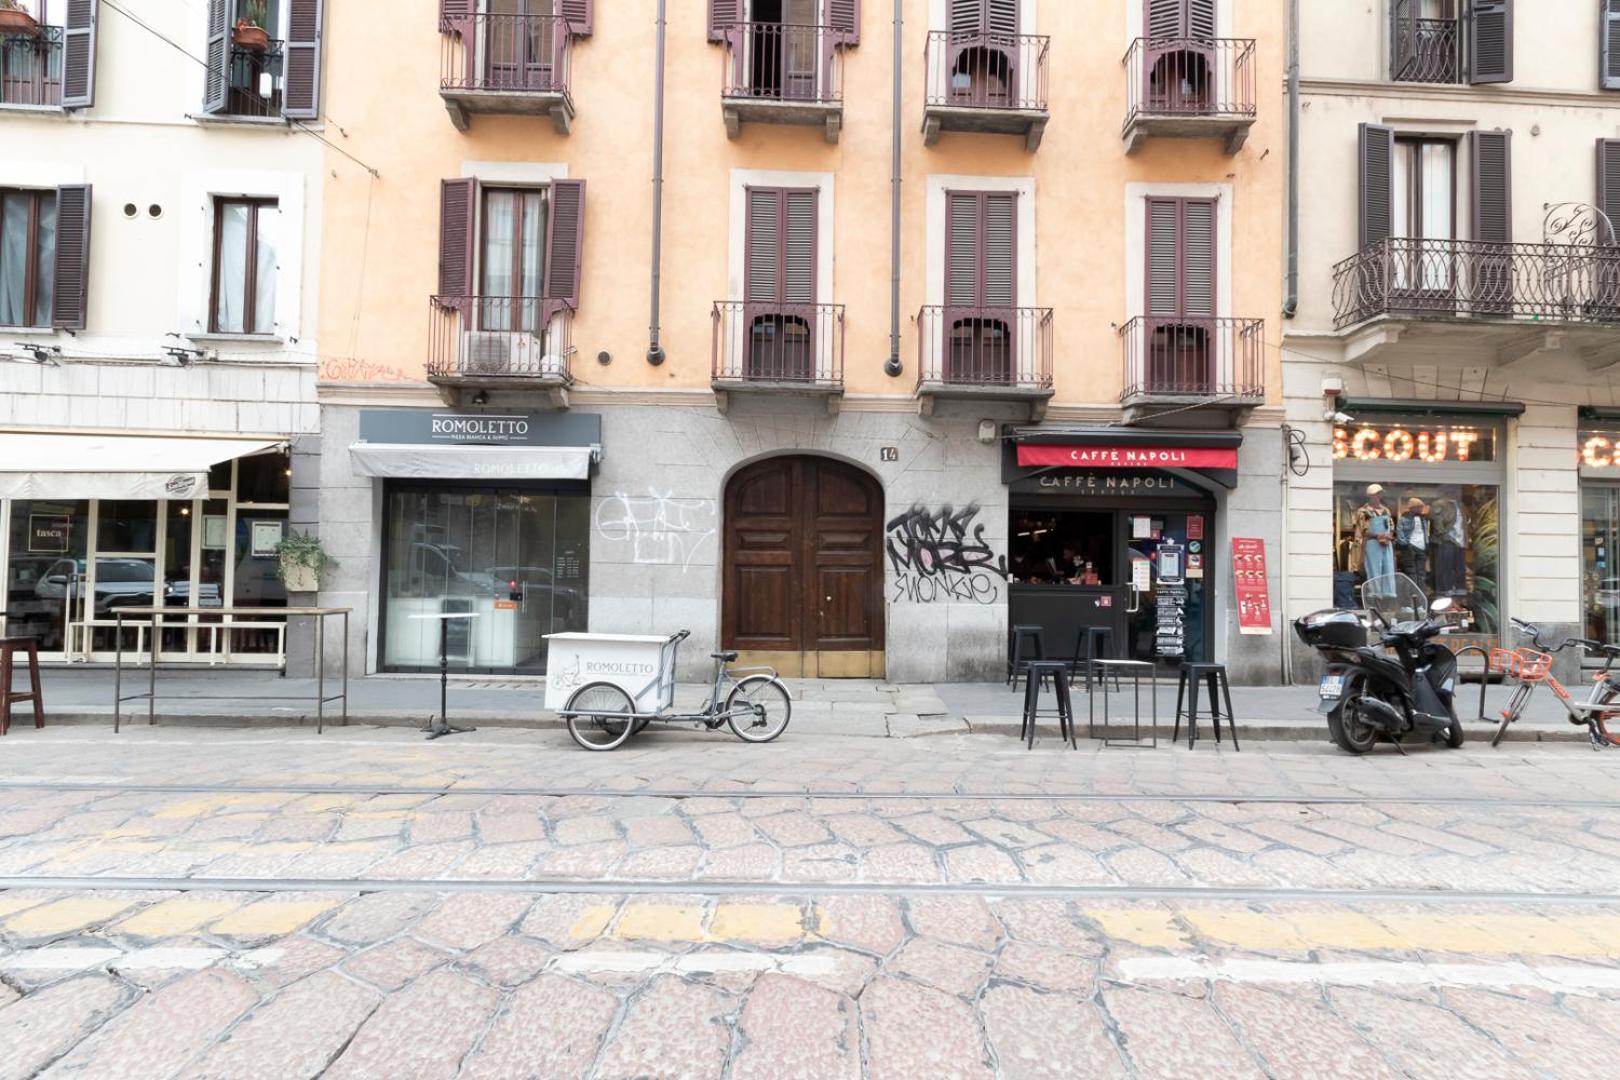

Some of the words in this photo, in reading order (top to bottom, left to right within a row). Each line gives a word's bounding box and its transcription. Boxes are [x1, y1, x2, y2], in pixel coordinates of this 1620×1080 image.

[432, 419, 528, 434] ROMOLETTO
[881, 448, 897, 461] 14
[1071, 448, 1119, 461] CAFFÈ
[1127, 451, 1185, 461] NAPOLI
[1040, 473, 1096, 487] CAFFÈ
[1106, 477, 1174, 488] NAPOLI
[36, 529, 62, 537] tasca
[586, 661, 654, 674] ROMOLETTO
